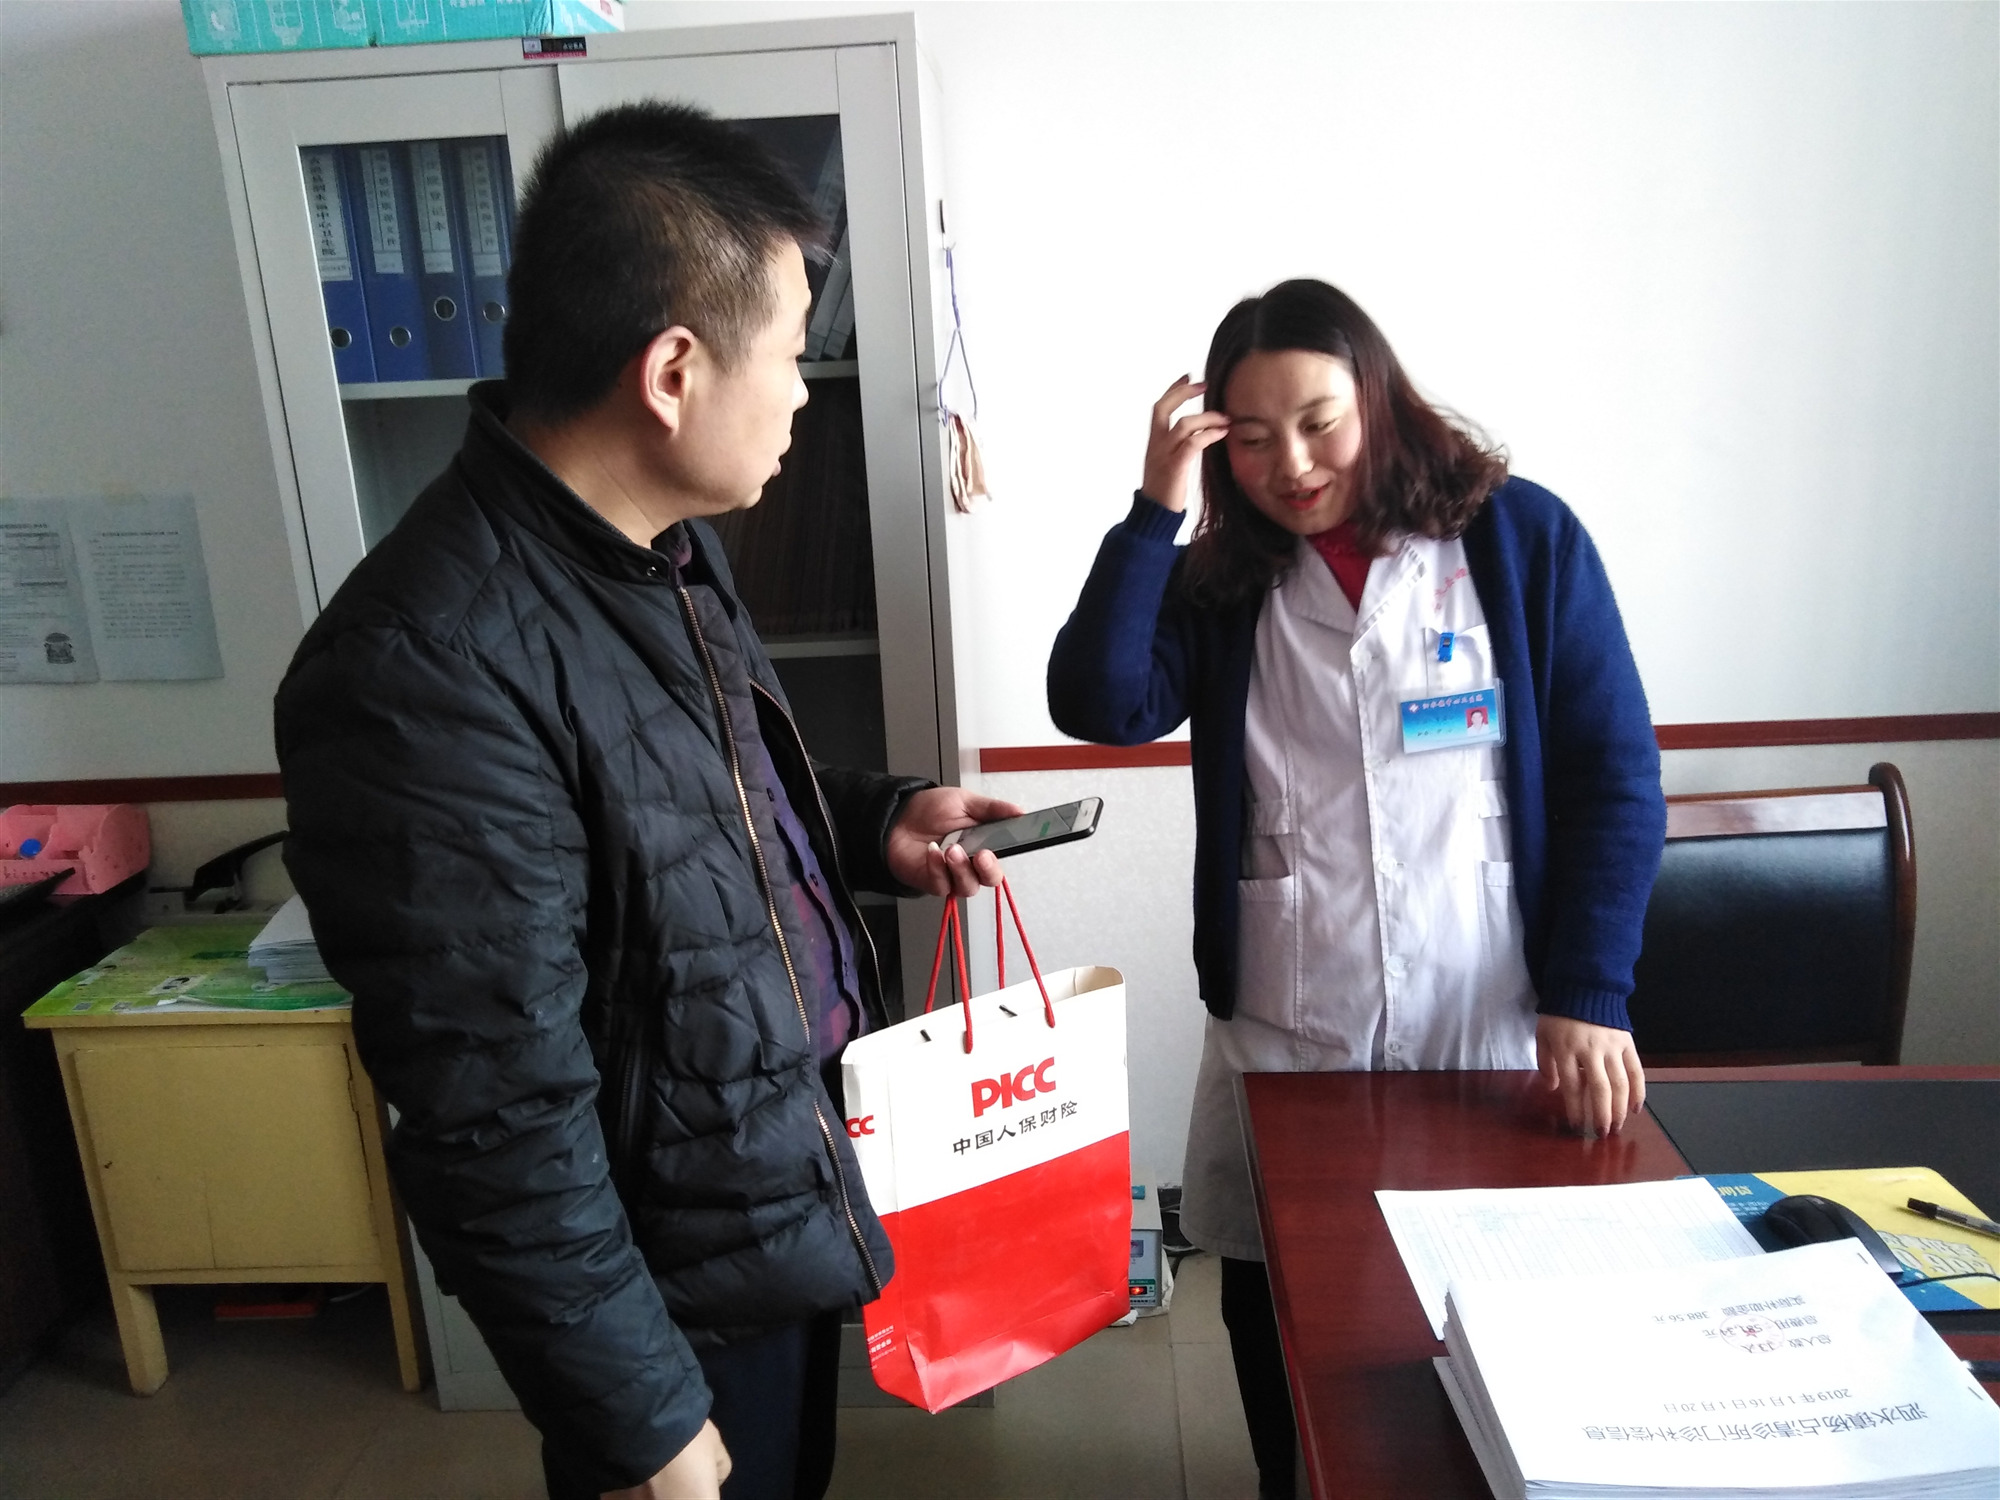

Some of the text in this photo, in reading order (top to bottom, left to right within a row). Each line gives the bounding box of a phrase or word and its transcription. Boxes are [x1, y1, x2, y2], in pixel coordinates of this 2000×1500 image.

[971, 1056, 1057, 1118] PICC
[953, 1100, 1078, 1156] 中国人保财险
[1580, 1401, 1929, 1443] 泗水镇杨占清诊所门诊补偿信息
